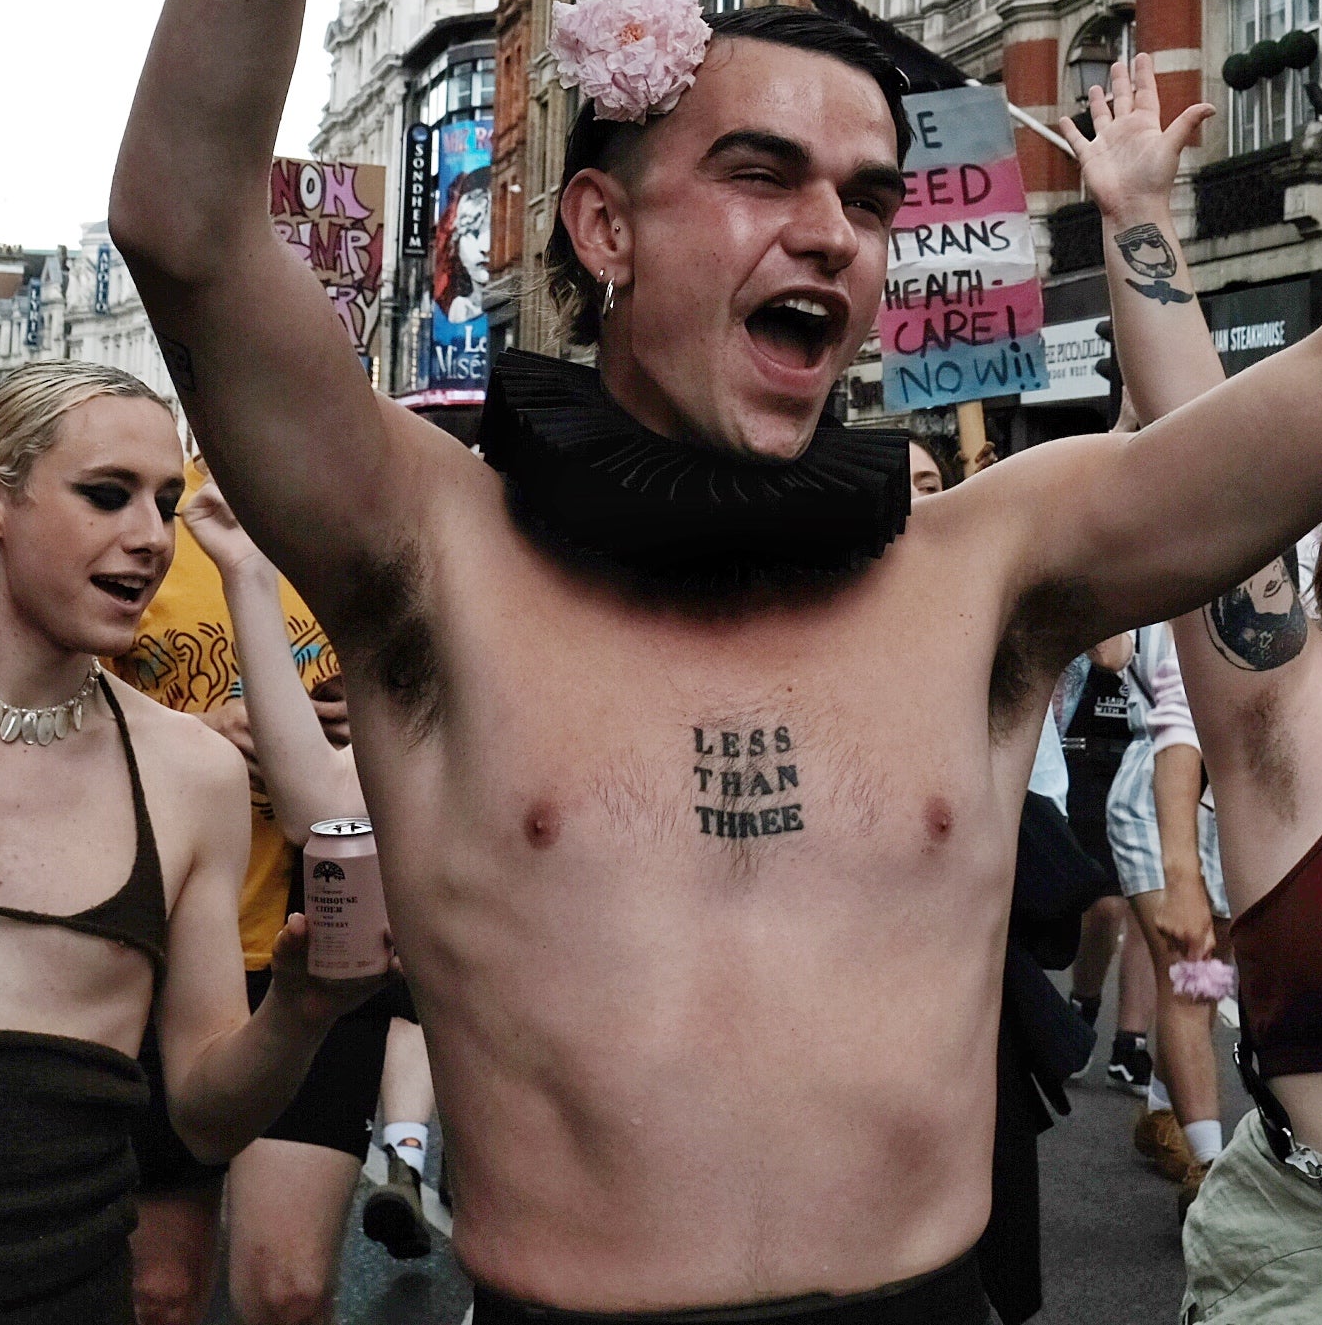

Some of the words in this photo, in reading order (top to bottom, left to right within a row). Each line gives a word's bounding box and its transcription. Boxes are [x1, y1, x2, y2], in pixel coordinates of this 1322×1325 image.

[917, 110, 942, 149] E
[270, 159, 374, 220] NON
[408, 143, 424, 248] SONDHEIM
[902, 163, 992, 206] EED
[890, 220, 1011, 262] TRANS
[95, 251, 109, 312] APOLLO
[27, 288, 39, 342] LYRIC
[1230, 320, 1285, 351] STEAKHOUSE
[693, 726, 791, 758] LESS
[693, 765, 800, 797] THAN
[695, 803, 804, 839] THREE
